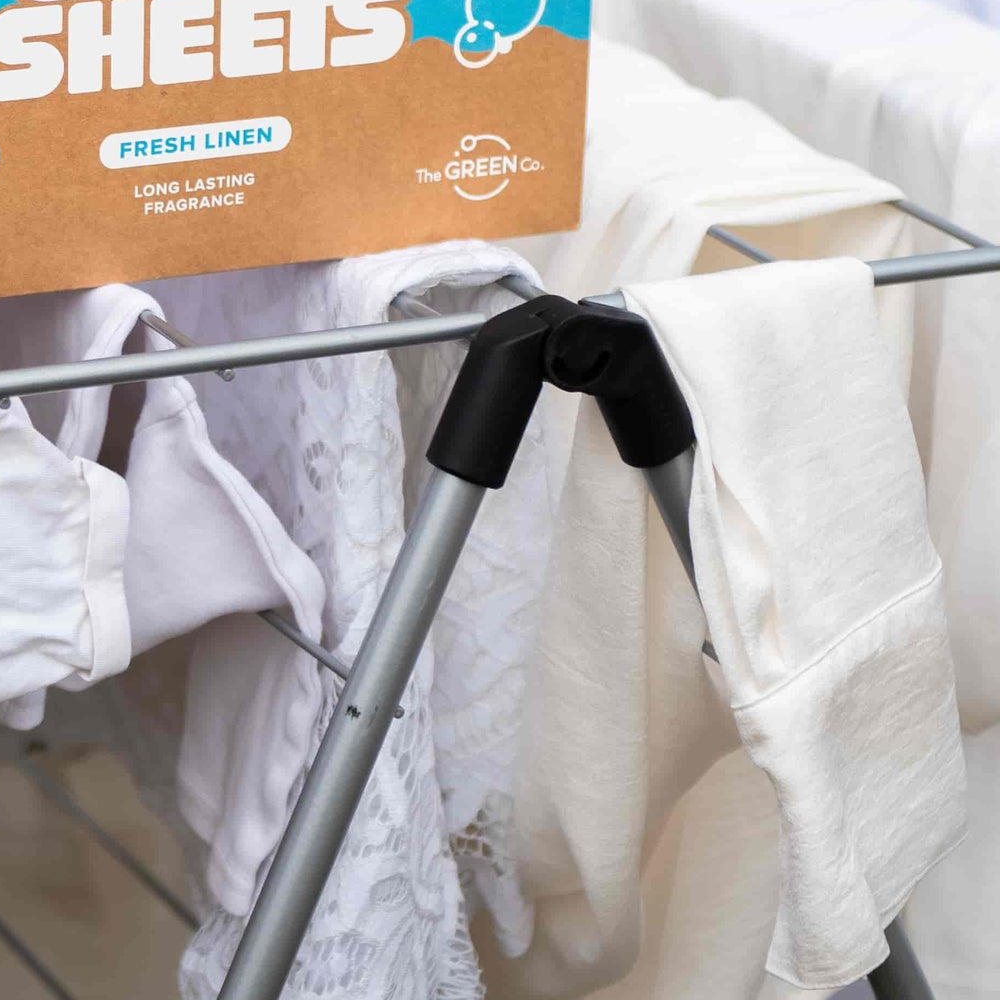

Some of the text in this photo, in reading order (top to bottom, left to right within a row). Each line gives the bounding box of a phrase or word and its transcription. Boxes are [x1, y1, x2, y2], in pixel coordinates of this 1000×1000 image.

[119, 126, 273, 159] FRESH LINEN
[415, 154, 545, 184] The GREEN Co.
[134, 172, 256, 199] LONG LASTING
[143, 191, 245, 216] FRAGRANCE
